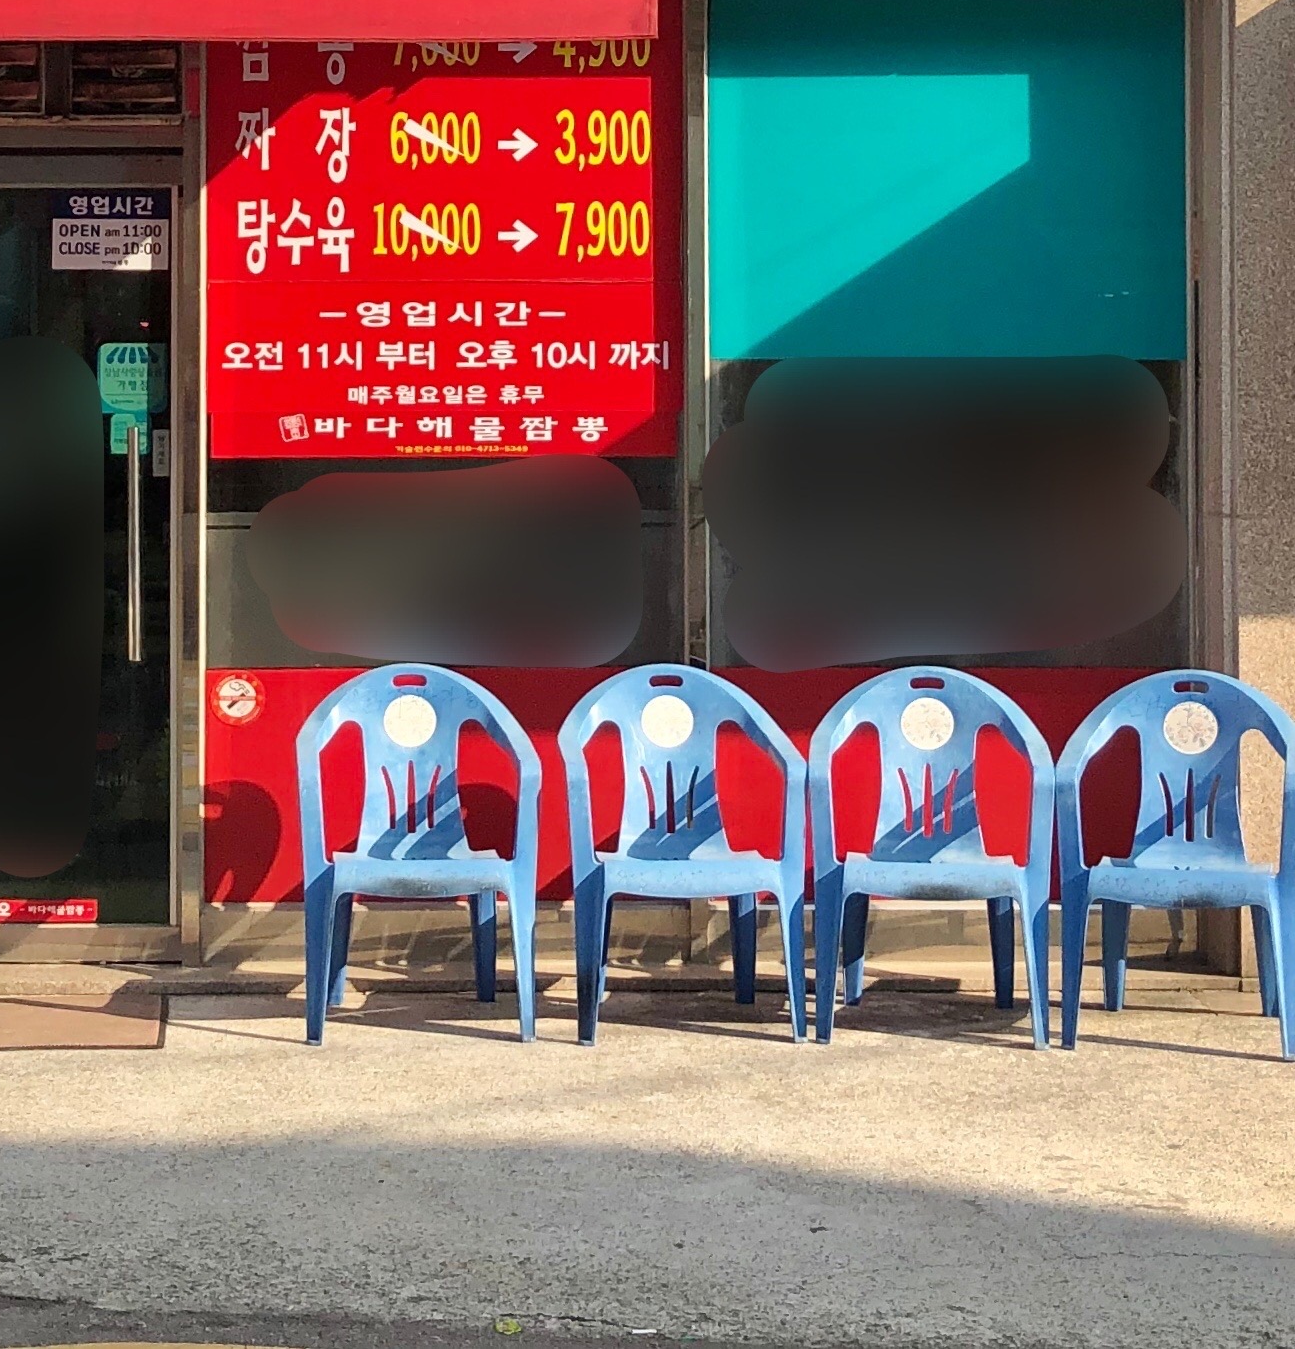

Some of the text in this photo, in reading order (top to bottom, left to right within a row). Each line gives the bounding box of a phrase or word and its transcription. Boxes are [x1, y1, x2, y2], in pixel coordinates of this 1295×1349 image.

[235, 107, 651, 183] 짜장 6,000 3,900
[69, 195, 154, 215] 영업시간
[59, 224, 162, 237] OPEN am 11:00
[237, 196, 650, 274] 탕수육 10,000 7,900
[59, 242, 162, 256] CLOSE pm 10:00
[221, 340, 670, 370] 오전 11시 부터 오후 10시 까지
[347, 385, 545, 405] 매주월요일은 휴무
[314, 416, 609, 442] 바다해물짬뽕
